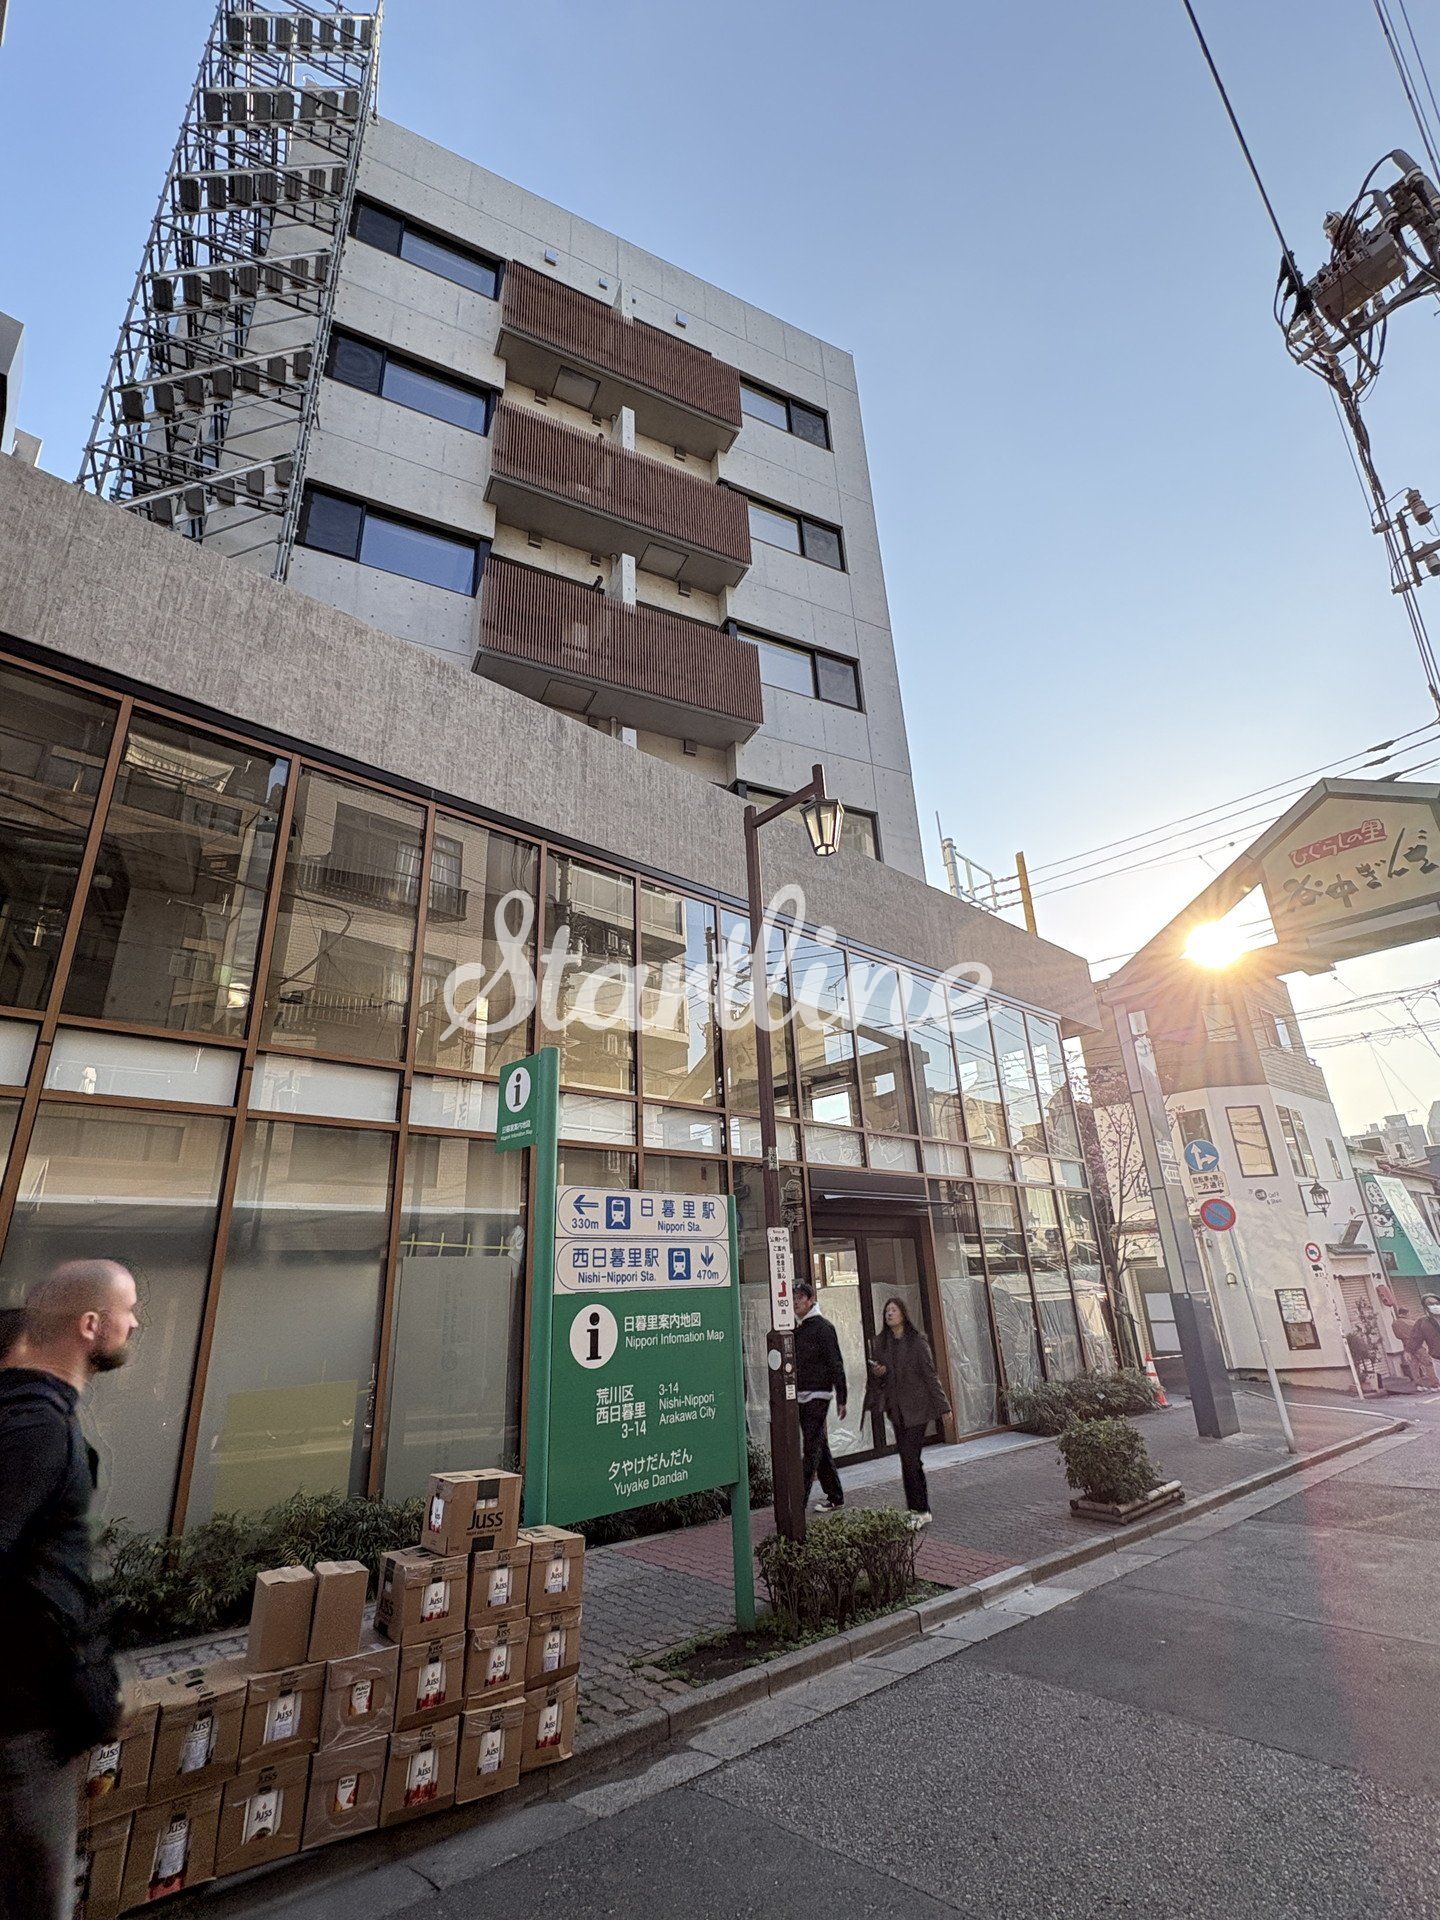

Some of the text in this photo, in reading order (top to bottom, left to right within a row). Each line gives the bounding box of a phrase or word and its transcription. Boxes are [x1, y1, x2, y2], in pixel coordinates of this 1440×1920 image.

[1283, 827, 1439, 912] 谷中ぎんざ
[640, 1198, 716, 1219] 日暮里駅
[571, 1218, 599, 1230] 330m
[657, 1221, 702, 1233] Nippori Sta.
[572, 1247, 660, 1268] 西日暮里駅
[577, 1271, 656, 1286] Nishi-Nippori Sta.
[696, 1269, 719, 1280] 470m
[624, 1312, 702, 1332] 日暮里案内地図
[625, 1335, 659, 1349] Nippori
[706, 1330, 725, 1344] Map
[596, 1384, 634, 1407] 荒川区
[659, 1382, 679, 1395] 3-14
[659, 1391, 715, 1411] Nishi-Nippori
[596, 1401, 646, 1426] 西日暮里
[659, 1406, 716, 1426] Arakawa City
[621, 1420, 646, 1439] 3-14
[608, 1447, 693, 1481] 夕やけだんだん
[614, 1469, 689, 1497] Yuyake Dandan
[467, 1510, 504, 1531] Juss
[550, 1571, 562, 1579] Juss
[494, 1580, 507, 1591] Juss
[429, 1596, 443, 1606] Juss
[491, 1660, 505, 1670] Juss
[425, 1677, 439, 1687] Juss
[275, 1709, 293, 1721] Juss
[190, 1720, 210, 1733] Juss
[543, 1721, 556, 1730] Juss
[97, 1746, 119, 1761] Juss
[485, 1747, 499, 1757] Juss
[416, 1767, 431, 1778] Juss
[255, 1810, 272, 1822] Juss
